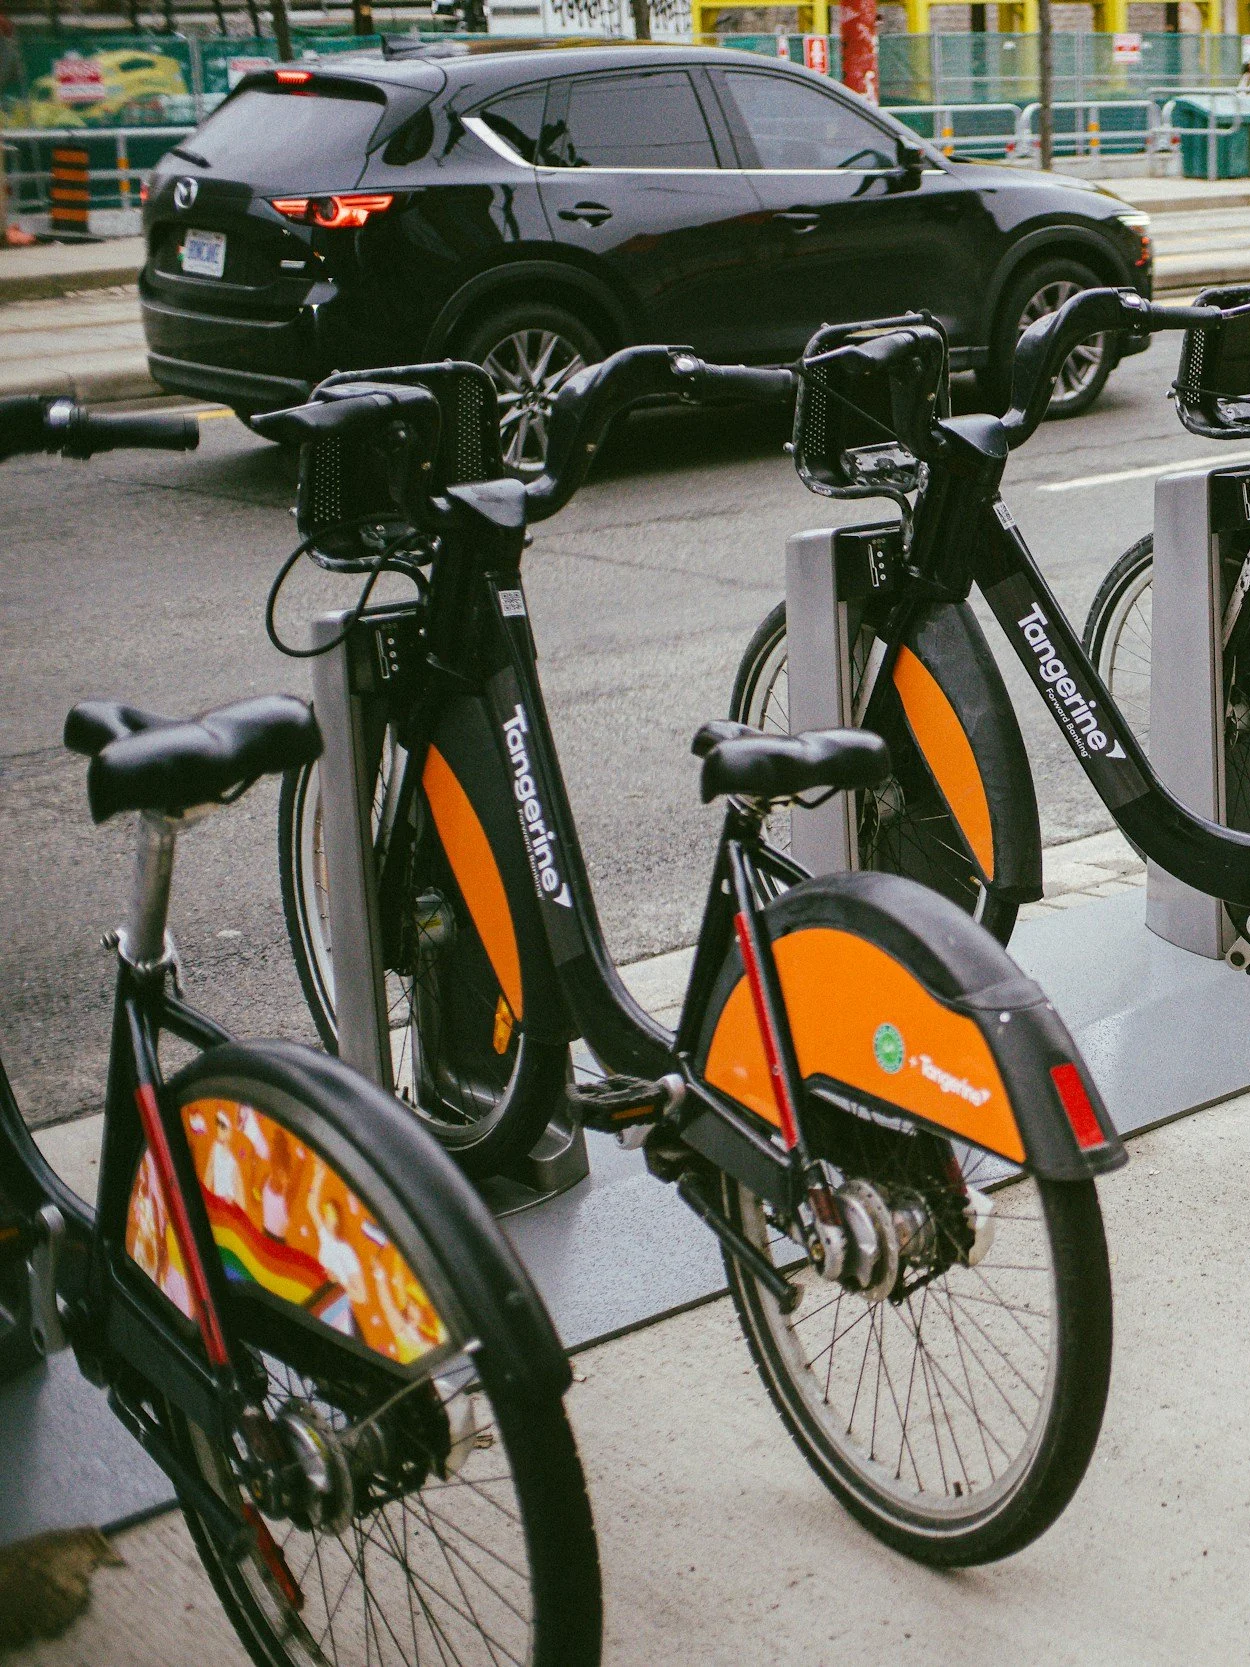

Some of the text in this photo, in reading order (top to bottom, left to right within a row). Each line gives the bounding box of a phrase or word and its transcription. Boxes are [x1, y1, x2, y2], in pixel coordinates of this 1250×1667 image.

[1017, 601, 1108, 751] Tangerine
[1045, 687, 1068, 723] Forward
[502, 703, 560, 892] Tangerine
[919, 1054, 983, 1107] Tangerine
